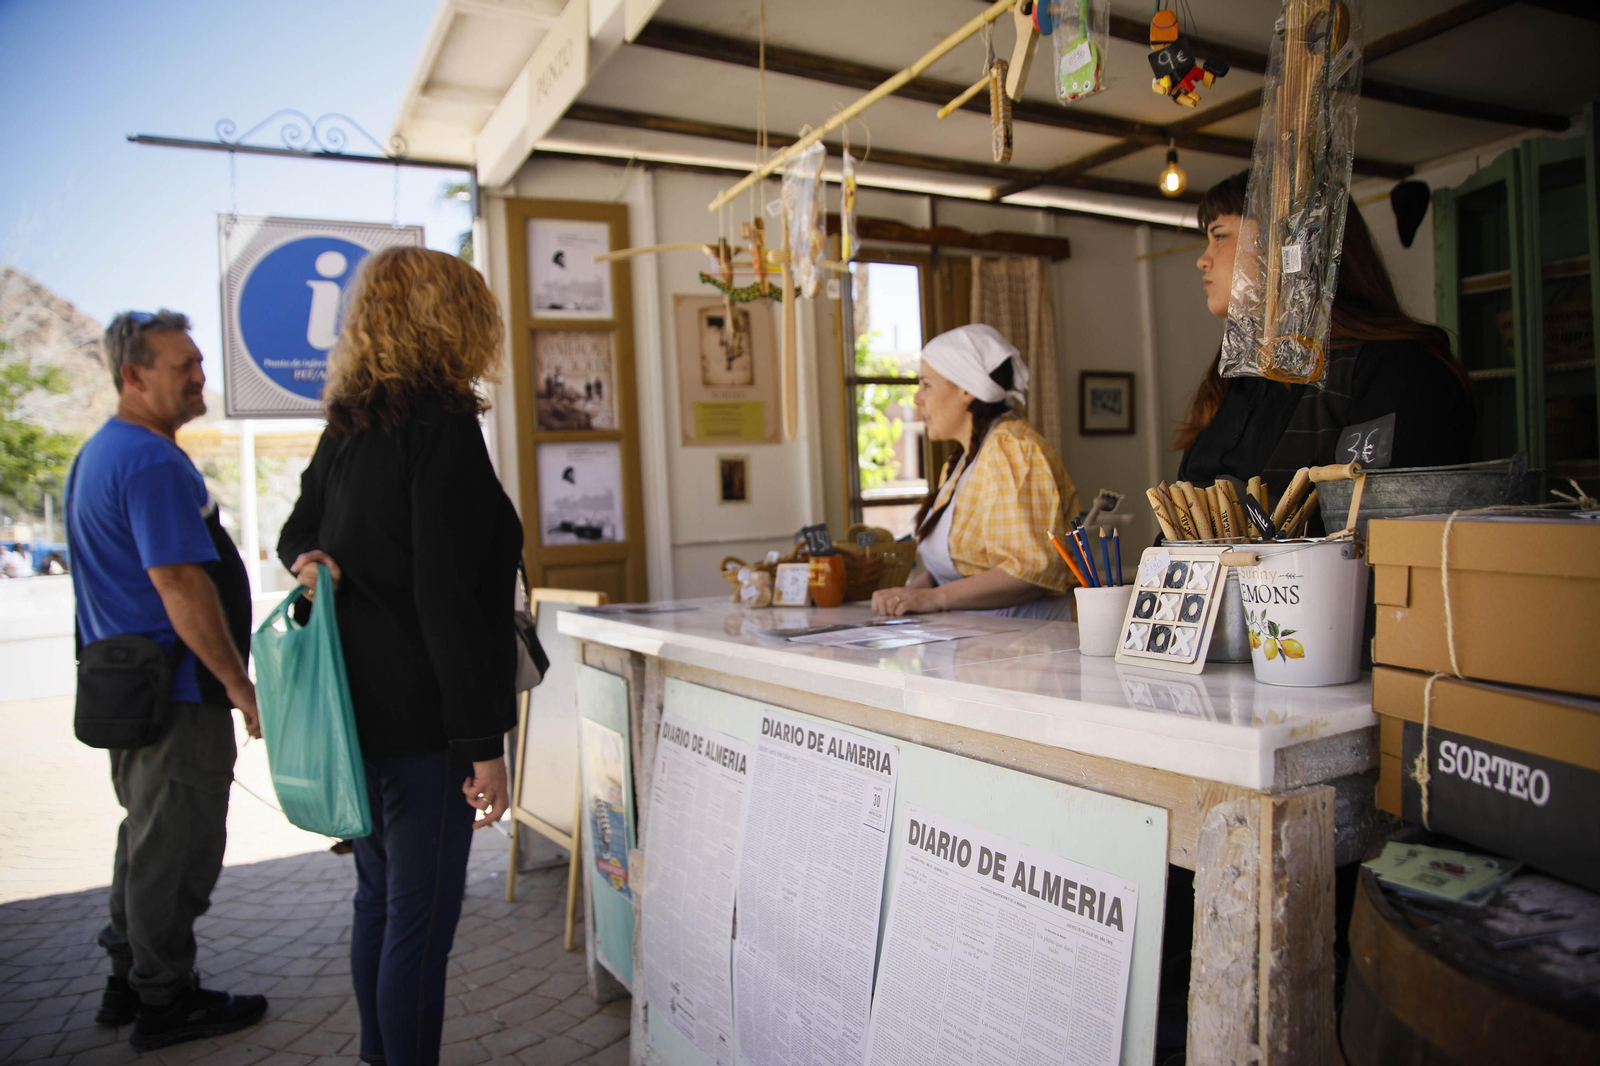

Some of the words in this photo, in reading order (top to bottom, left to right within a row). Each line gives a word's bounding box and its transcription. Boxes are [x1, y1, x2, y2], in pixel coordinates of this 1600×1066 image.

[536, 38, 574, 104] PUNTO
[263, 358, 289, 368] Punto
[291, 358, 301, 367] de
[1240, 583, 1300, 605] EMONS
[662, 721, 689, 749] DIARIO
[692, 733, 703, 755] DE
[704, 741, 746, 776] ALMERIA
[762, 717, 805, 747] DIARIO
[807, 730, 825, 754] DE
[827, 736, 892, 776] ALMERIA
[1437, 739, 1552, 808] SORTEO
[873, 793, 881, 808] 30
[908, 818, 972, 868] DIARIO
[977, 845, 1007, 883] DE
[1011, 860, 1124, 932] ALMERIA
